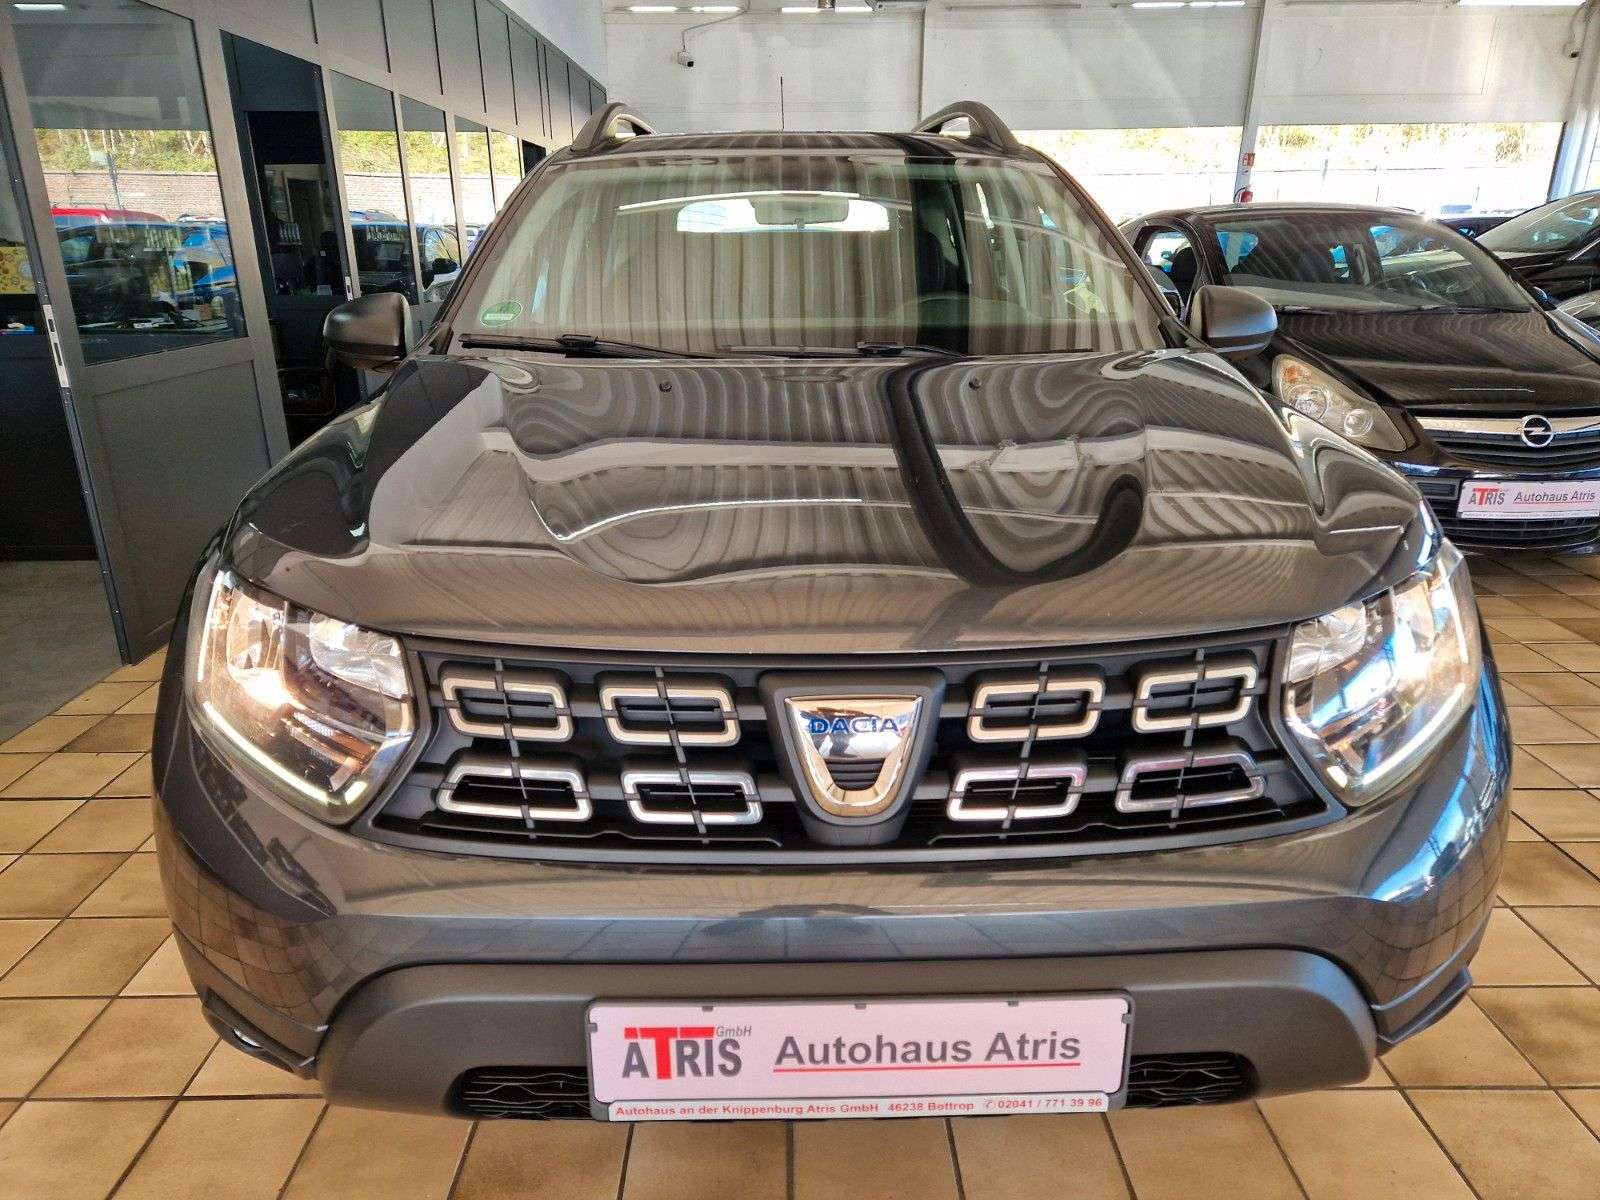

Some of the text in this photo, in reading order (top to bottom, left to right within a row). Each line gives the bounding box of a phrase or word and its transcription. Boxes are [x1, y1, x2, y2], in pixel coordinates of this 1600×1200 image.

[1513, 490, 1595, 502] Autohaus Atris
[809, 716, 899, 735] DACIA
[716, 1025, 752, 1037] GmbH
[622, 1026, 742, 1080] ATRIS
[774, 1031, 1081, 1066] Autohaus Atris
[615, 1106, 676, 1116] Autohaus
[679, 1107, 695, 1115] an
[698, 1105, 718, 1115] der
[722, 1104, 804, 1115] Knippenburg
[806, 1104, 836, 1114] Atris
[840, 1103, 879, 1113] GmbH
[887, 1102, 924, 1112] 46238
[928, 1101, 974, 1112] Bottrop
[997, 1099, 1033, 1109] 02041
[1045, 1098, 1065, 1108] 771
[1070, 1098, 1084, 1107] 39
[1087, 1097, 1103, 1107] 96
